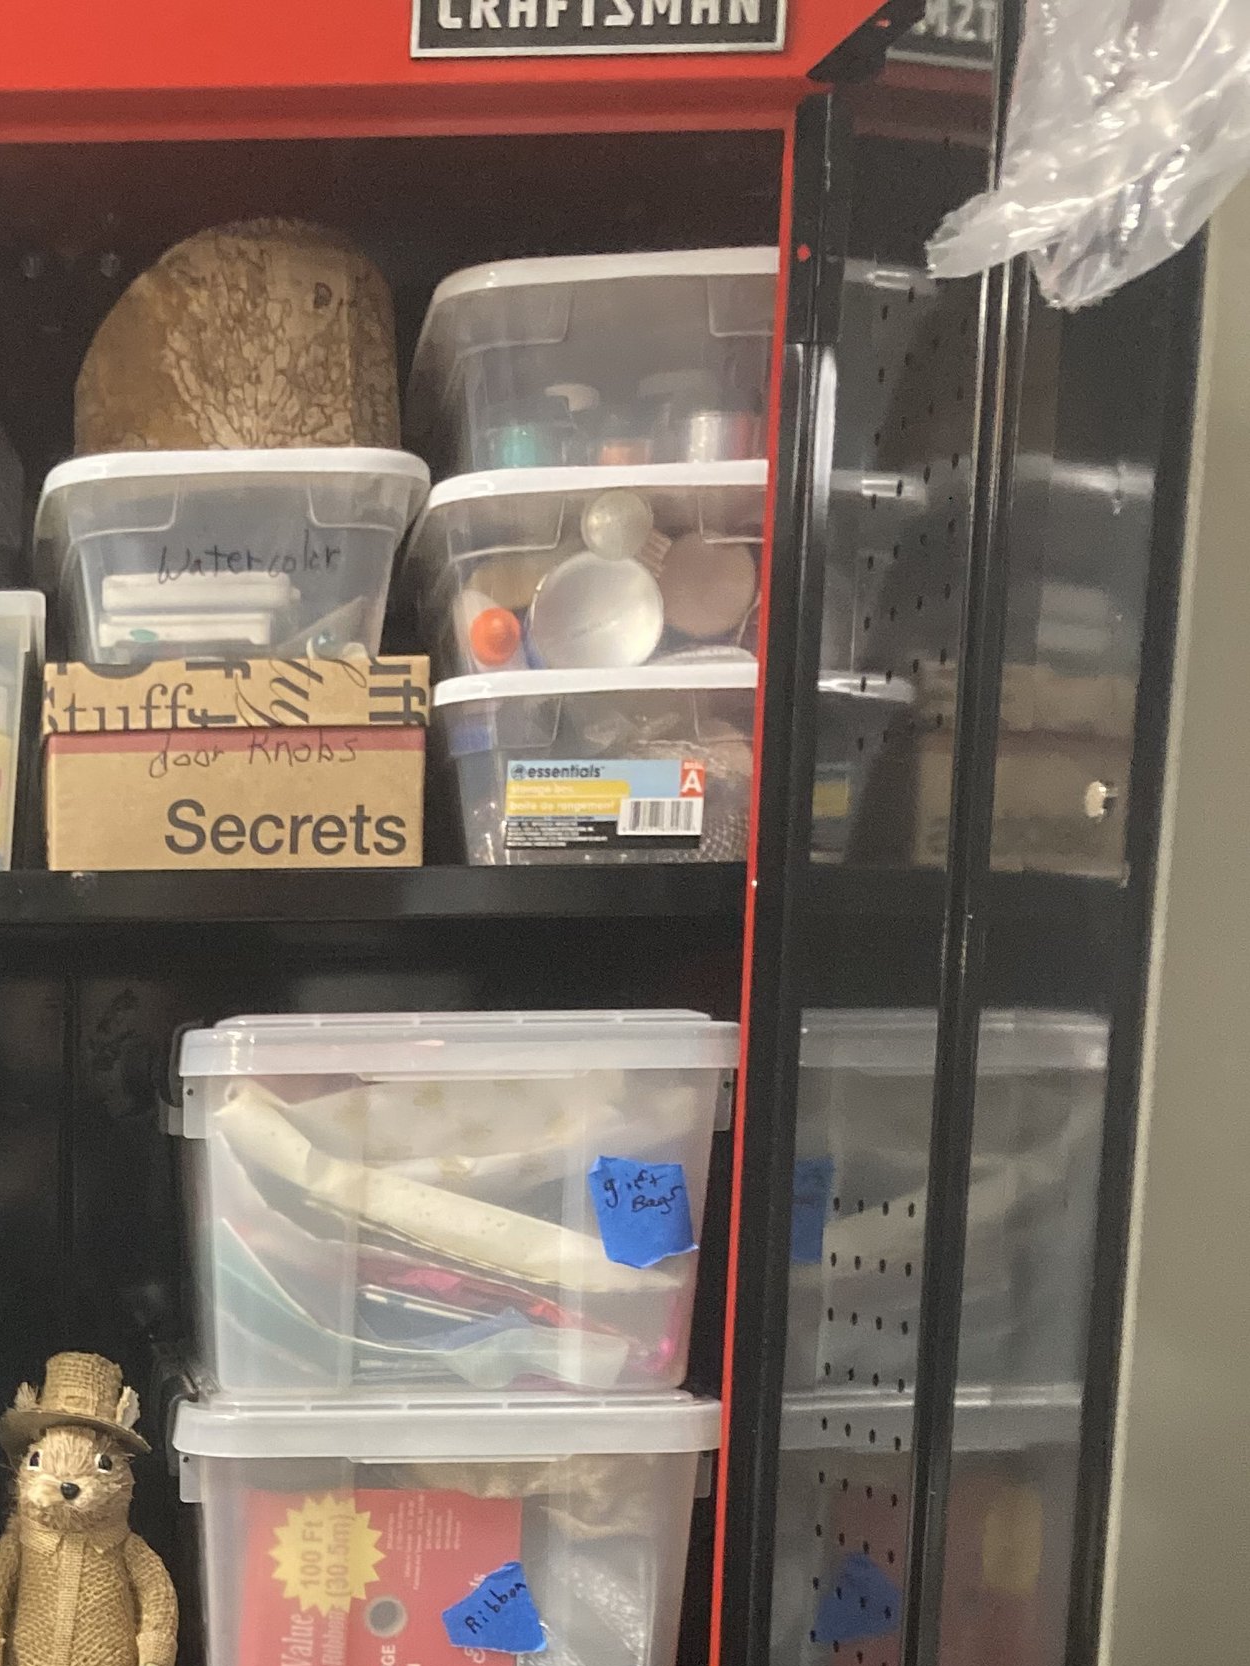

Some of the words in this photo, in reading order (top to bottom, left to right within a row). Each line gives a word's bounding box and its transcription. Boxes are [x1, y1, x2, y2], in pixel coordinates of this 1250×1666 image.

[437, 0, 761, 29] CRAFTSMAN
[156, 529, 341, 584] Watercolor
[527, 764, 602, 779] essentials
[681, 769, 703, 793] A
[163, 798, 407, 857] Secrets
[300, 1519, 324, 1545] Ft
[300, 1551, 323, 1588] 100
